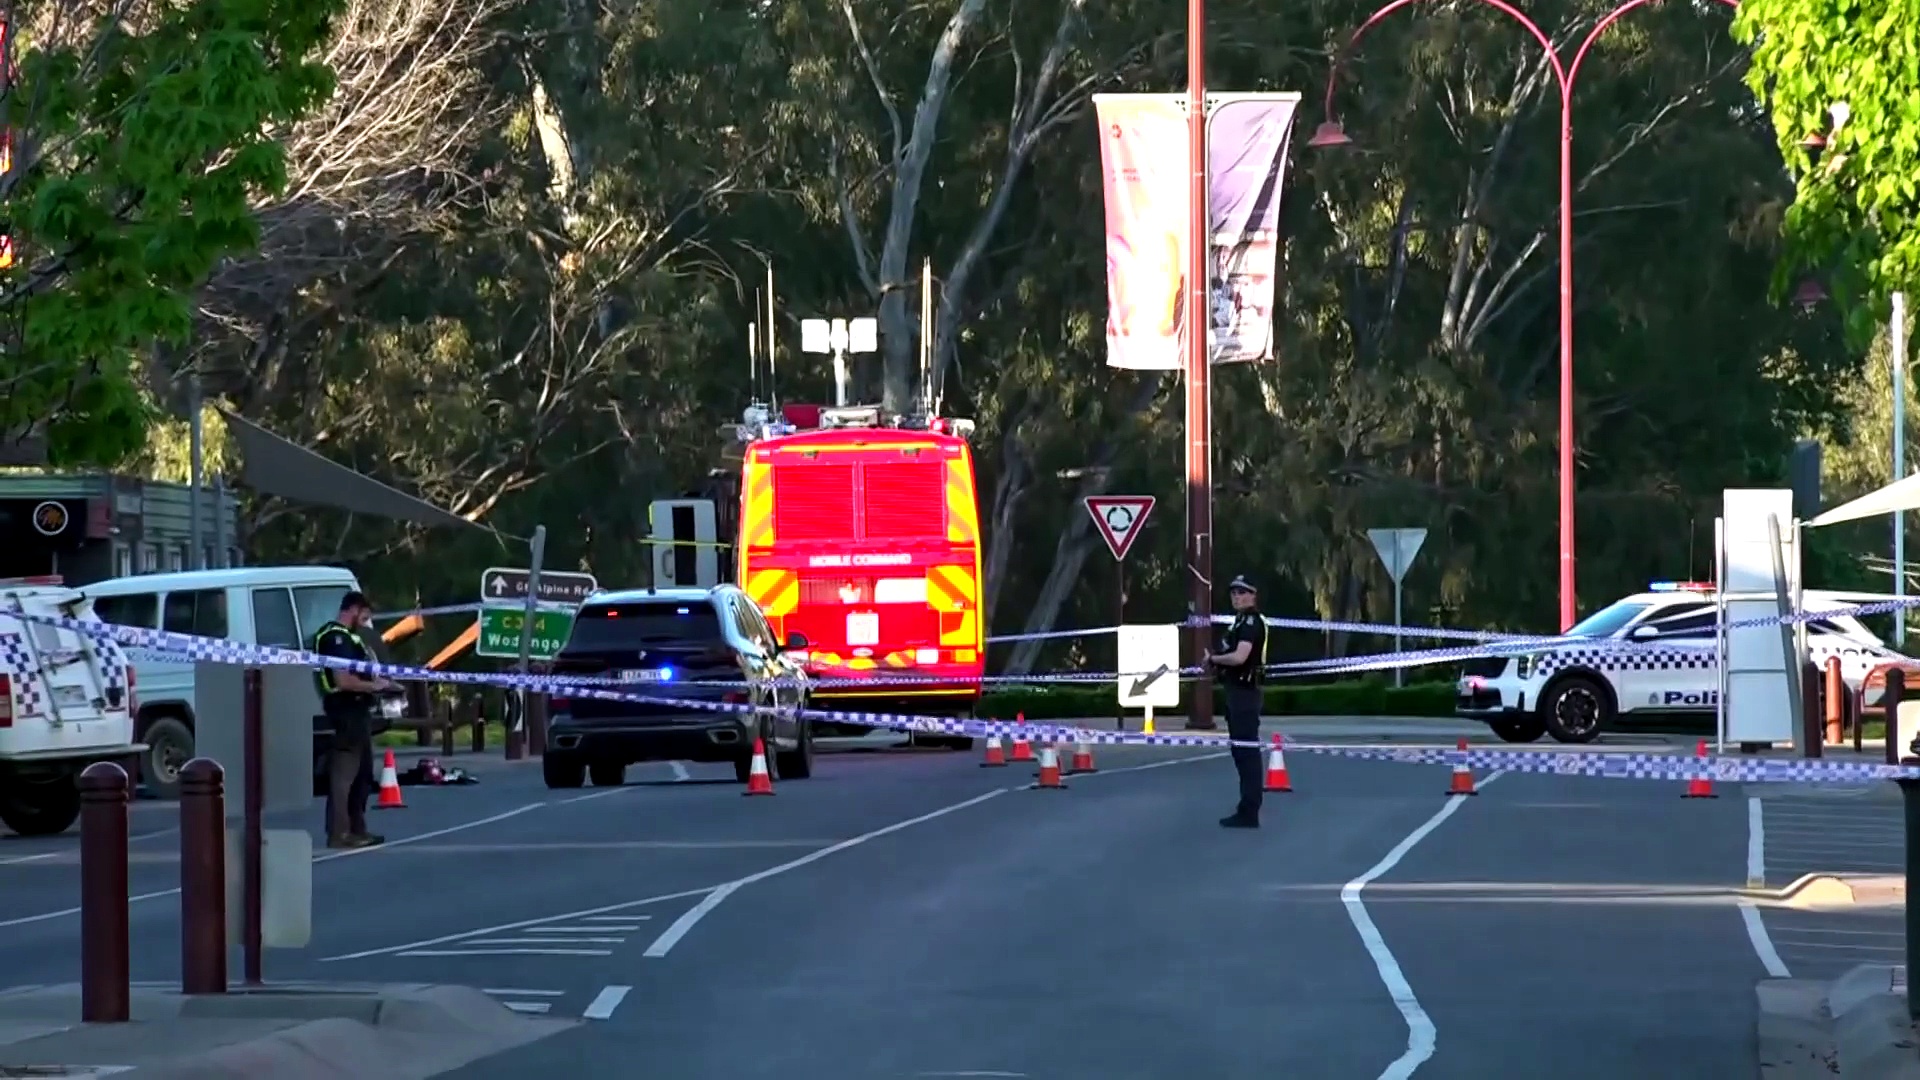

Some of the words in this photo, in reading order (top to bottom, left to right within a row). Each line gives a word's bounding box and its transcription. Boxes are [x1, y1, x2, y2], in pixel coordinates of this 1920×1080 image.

[530, 582, 569, 595] lpine
[487, 633, 560, 652] Wodnga
[1664, 690, 1718, 705] Poli
